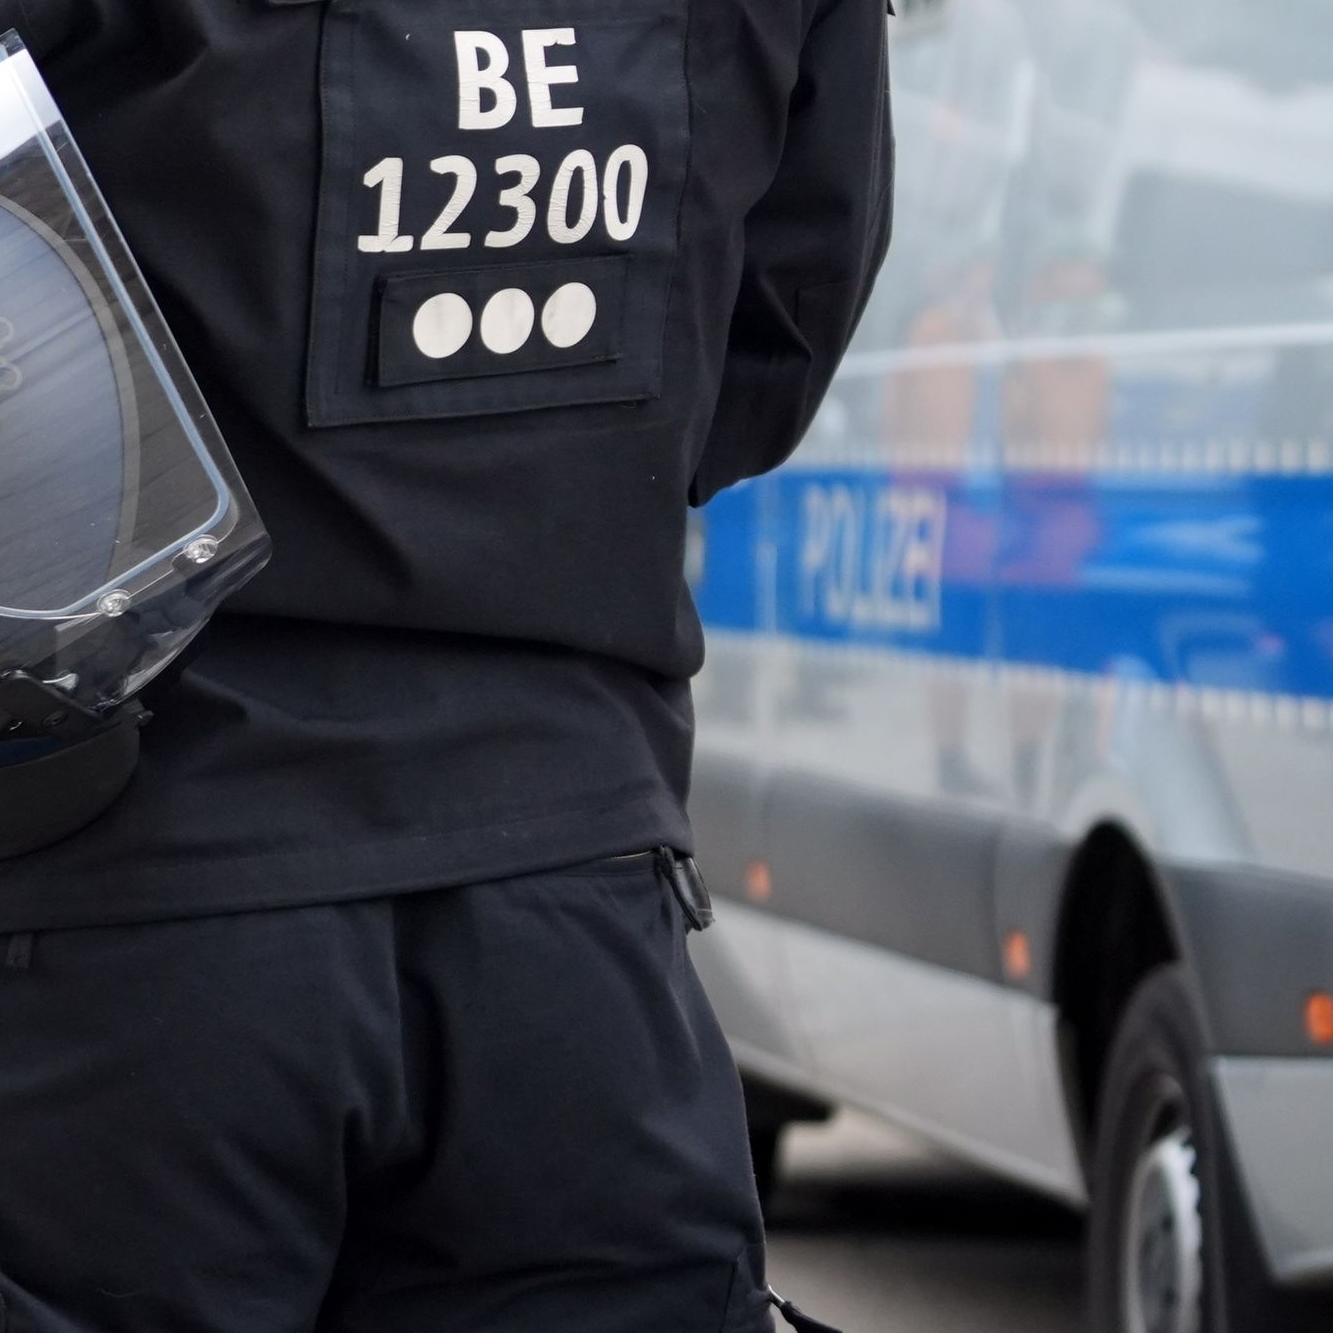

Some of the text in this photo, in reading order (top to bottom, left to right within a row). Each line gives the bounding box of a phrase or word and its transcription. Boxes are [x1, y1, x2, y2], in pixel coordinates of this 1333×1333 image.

[454, 27, 584, 130] BE
[357, 144, 649, 253] 12300
[800, 483, 947, 632] POLIZEI
